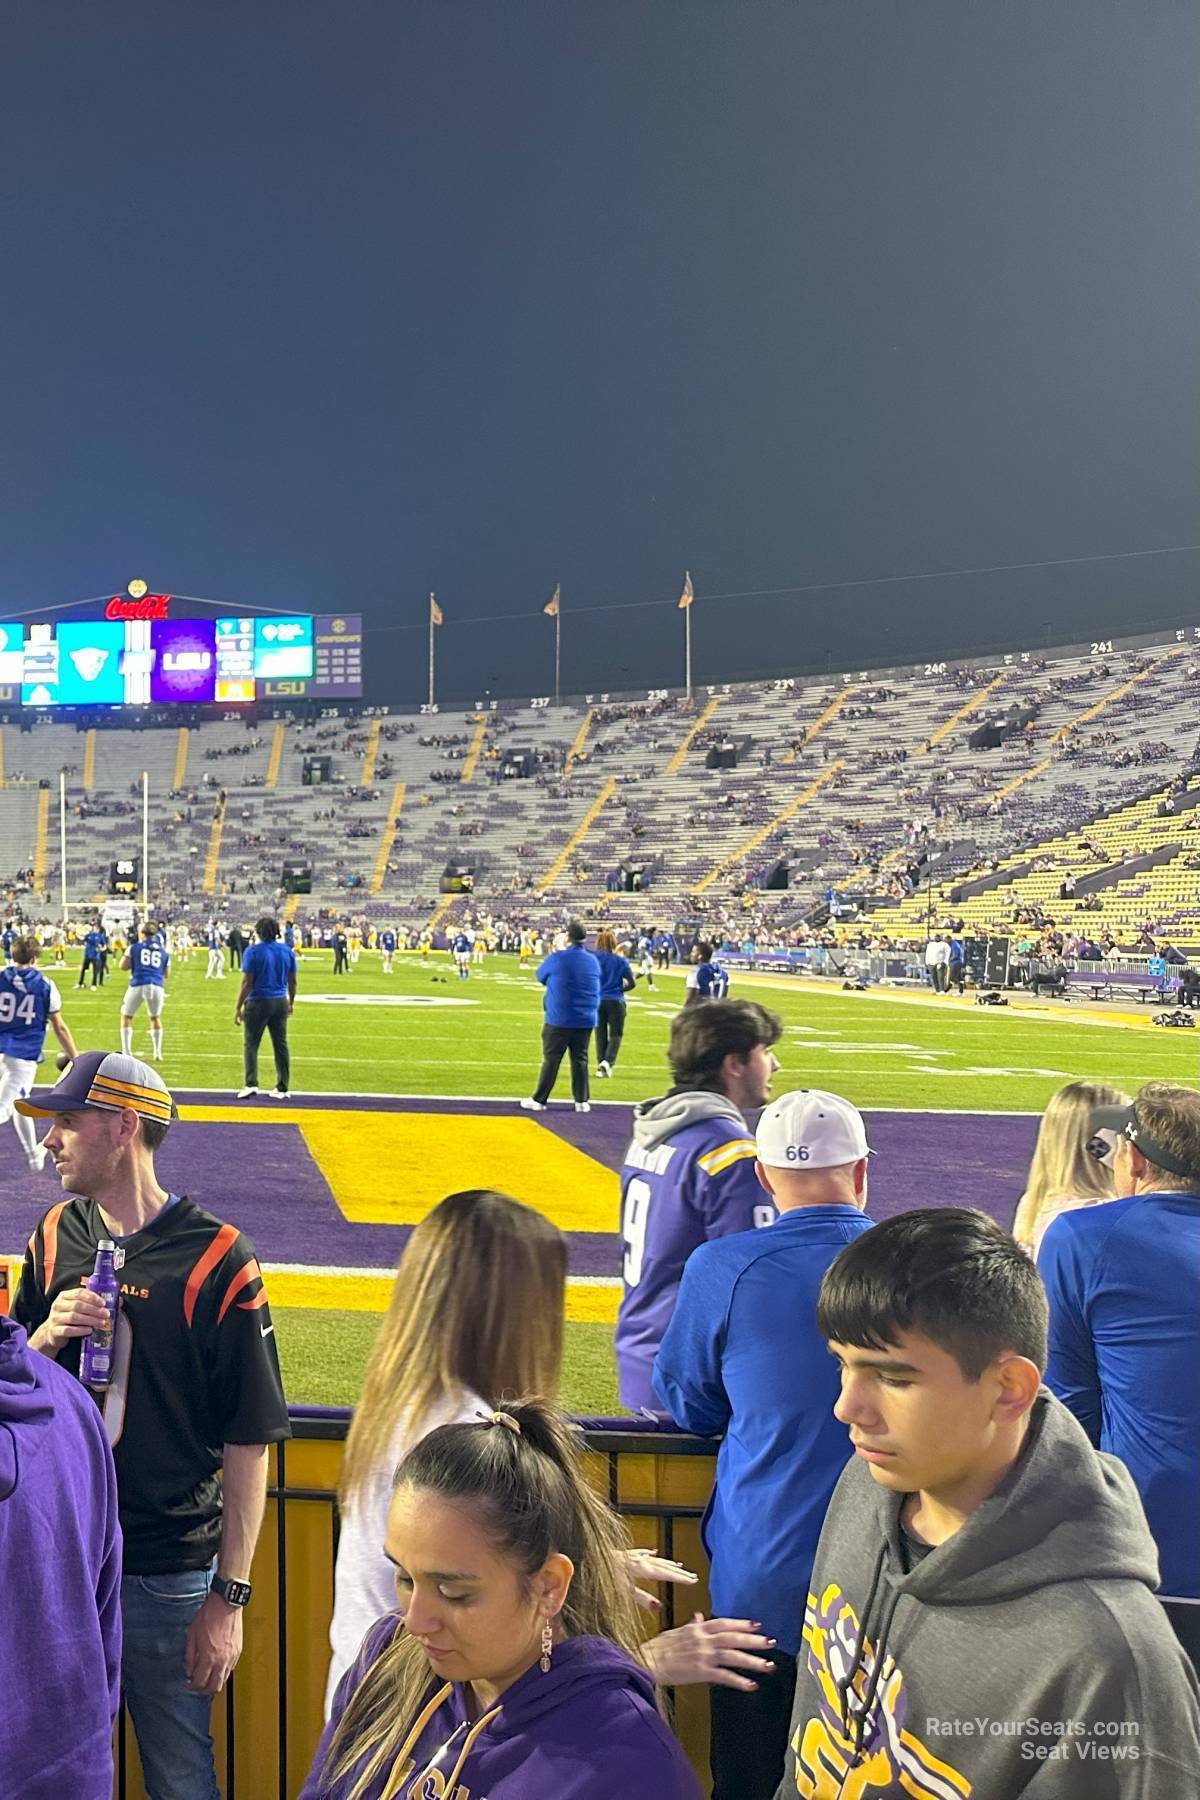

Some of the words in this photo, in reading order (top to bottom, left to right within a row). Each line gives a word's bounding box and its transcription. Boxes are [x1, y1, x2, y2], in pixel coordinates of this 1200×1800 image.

[1090, 641, 1113, 654] 241
[925, 663, 947, 675] 240
[264, 681, 305, 695] LSU
[774, 679, 794, 690] 239
[648, 689, 668, 700] 238
[531, 697, 550, 708] 237
[224, 712, 241, 720] 234
[321, 708, 338, 718] 235
[140, 948, 162, 968] 66
[786, 1145, 810, 1161] 66
[623, 1177, 651, 1288] 9
